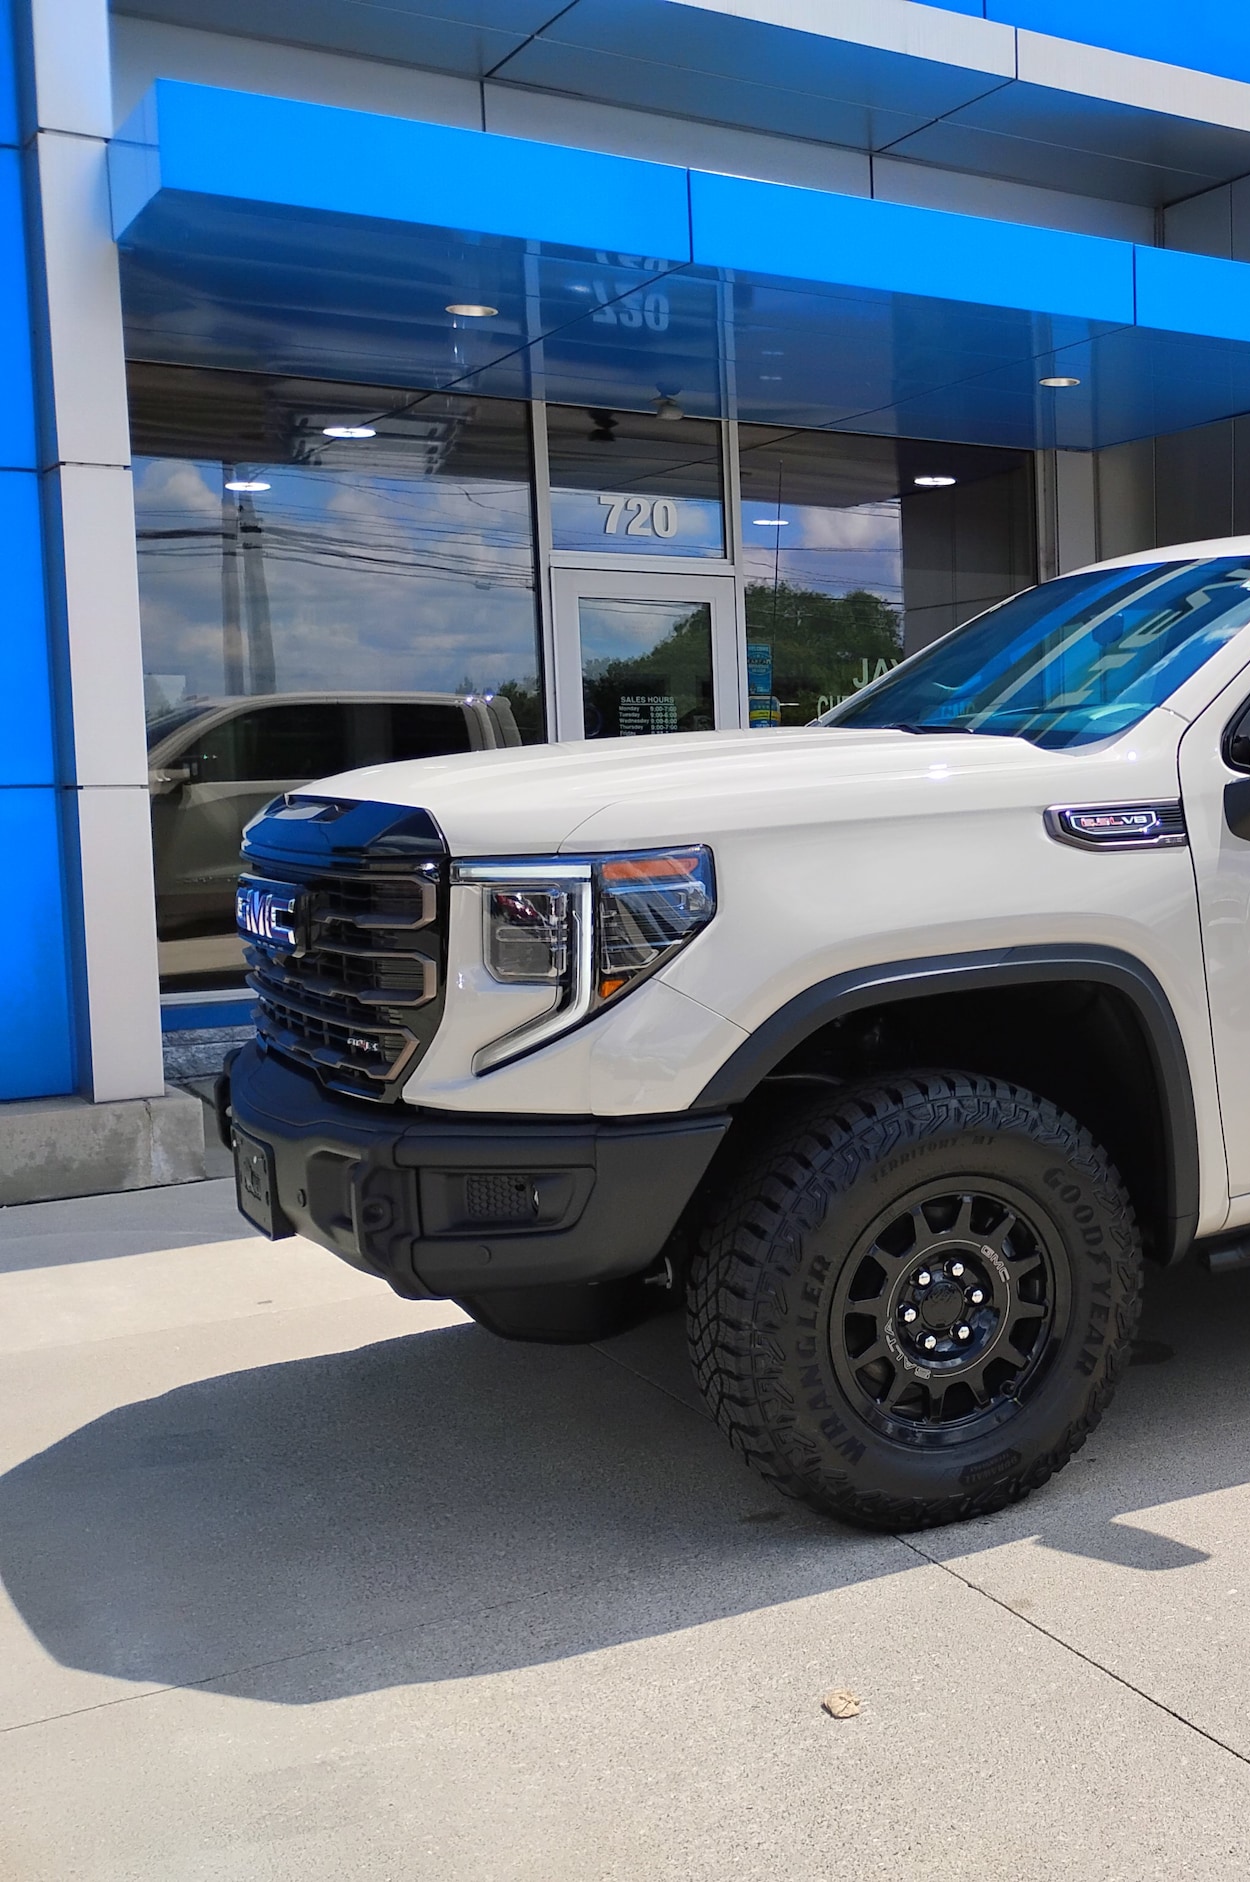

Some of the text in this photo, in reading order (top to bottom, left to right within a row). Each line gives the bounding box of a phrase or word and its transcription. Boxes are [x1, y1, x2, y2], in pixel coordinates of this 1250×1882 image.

[599, 495, 678, 538] 720
[236, 888, 296, 945] GMC
[981, 1244, 1010, 1283] GMC
[1043, 1167, 1113, 1377] GOODYEAR
[796, 1254, 868, 1466] WRANGLER
